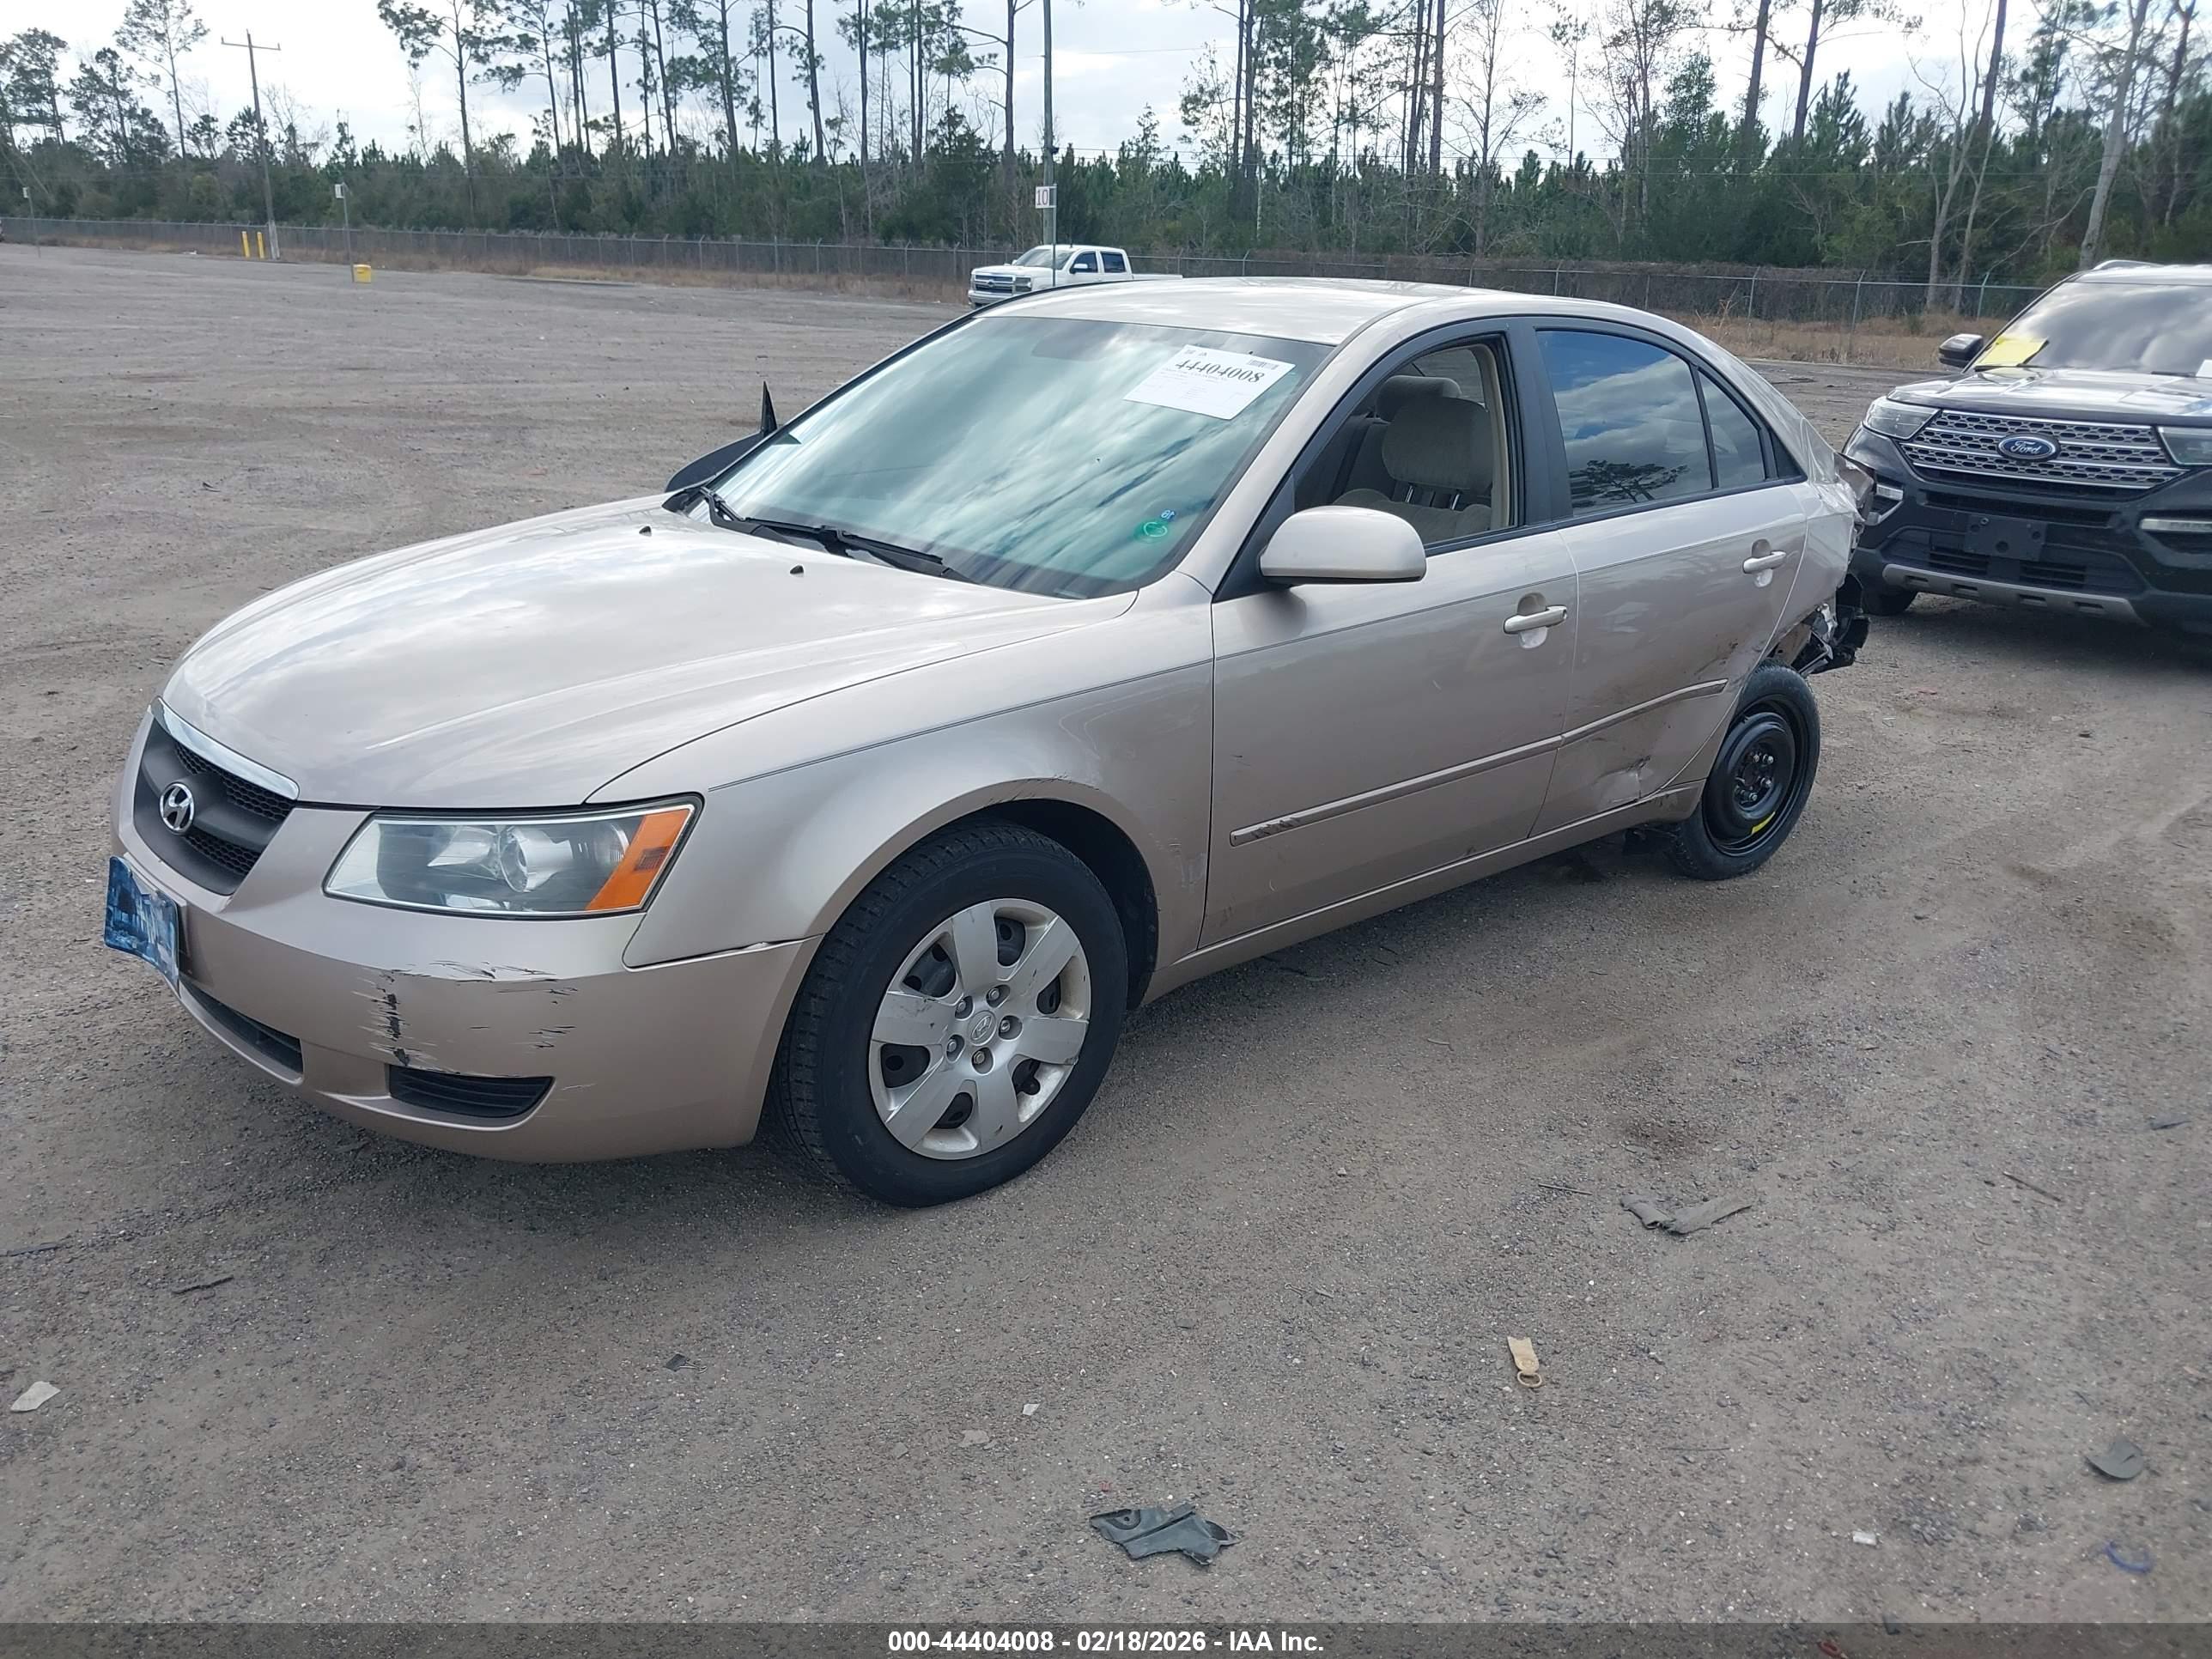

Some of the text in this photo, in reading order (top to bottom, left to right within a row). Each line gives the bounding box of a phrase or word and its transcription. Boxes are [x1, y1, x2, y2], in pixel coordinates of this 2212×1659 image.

[1036, 189, 1048, 205] 10
[1175, 359, 1265, 383] 44404008
[2010, 440, 2042, 454] Ford
